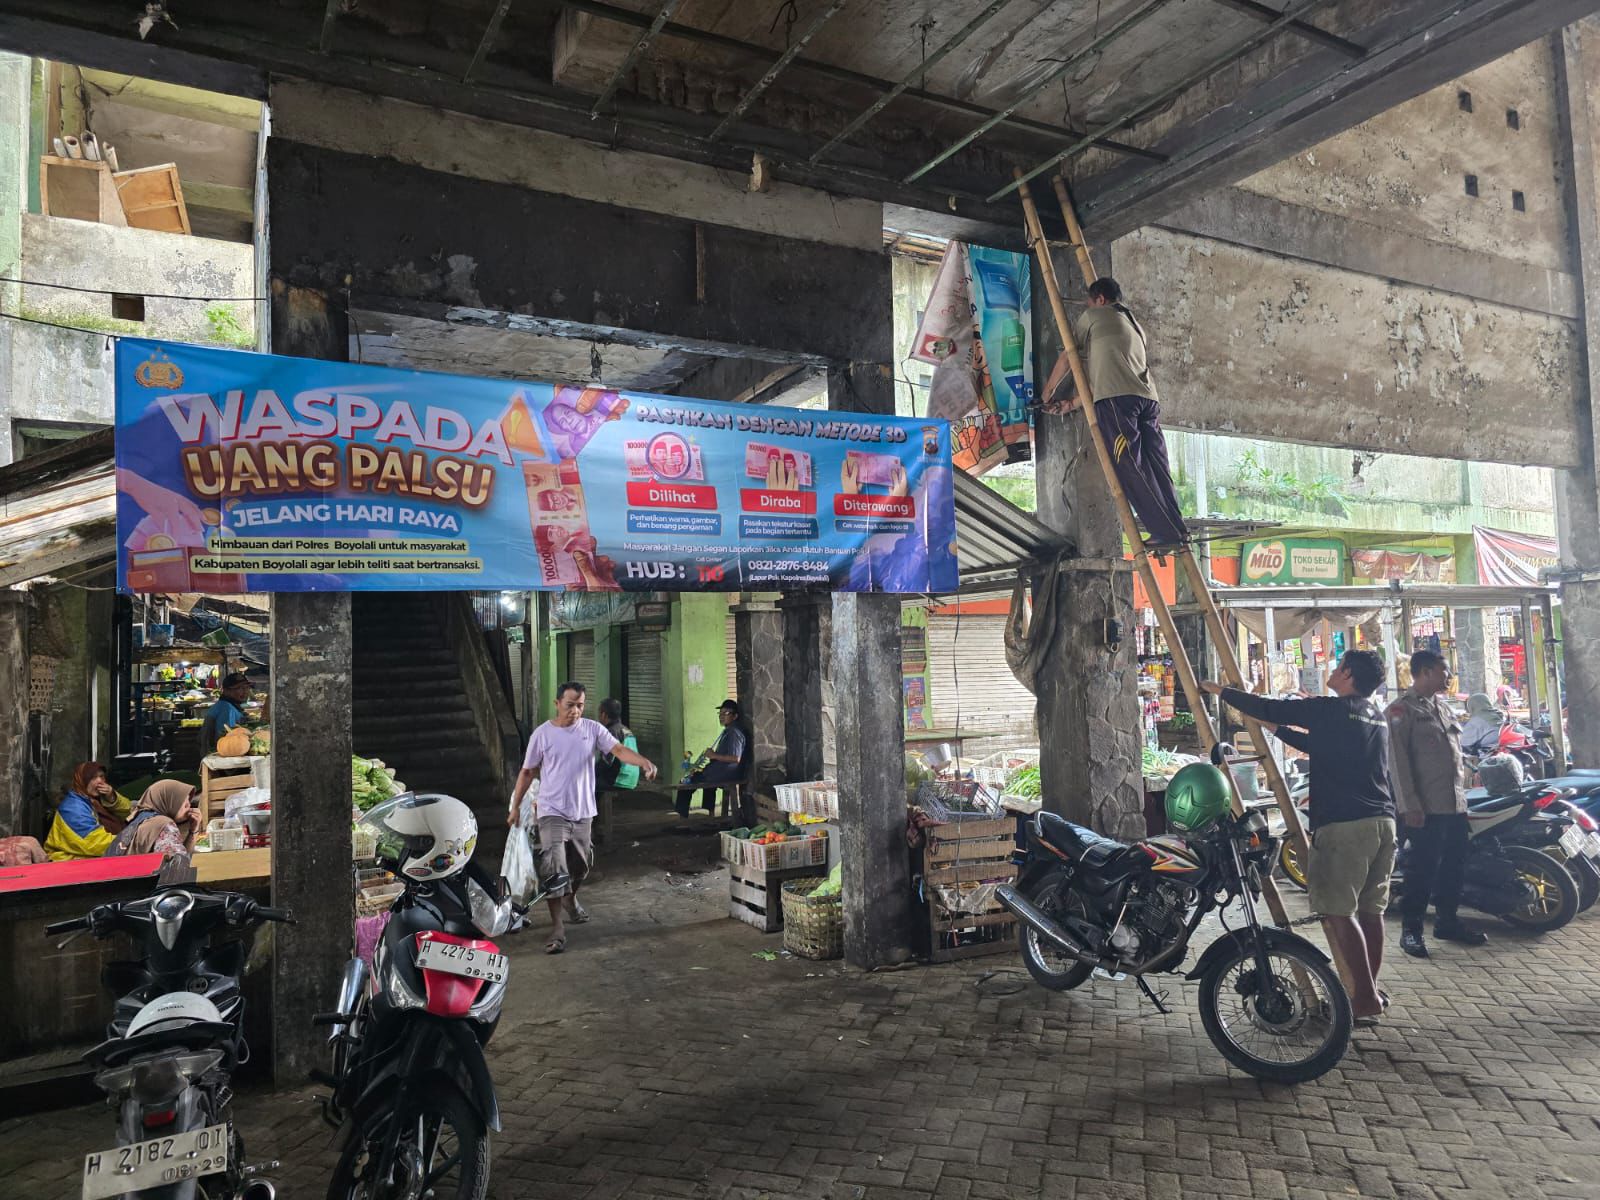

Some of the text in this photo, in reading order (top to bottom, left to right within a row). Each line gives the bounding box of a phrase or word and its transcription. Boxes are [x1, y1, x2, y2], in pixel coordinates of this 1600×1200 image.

[156, 389, 515, 466] WASPADA
[636, 404, 907, 444] PASTIKAN DENGAN METODE 3D
[185, 443, 493, 506] UANG PALSU
[649, 489, 697, 503] Dilihat
[760, 495, 801, 508] Diraba
[843, 499, 909, 514] Diterawang
[232, 504, 460, 532] JELANG HARI RAYA
[630, 513, 668, 522] Perhatikan
[743, 519, 771, 527] Rasakan
[771, 520, 793, 528] tekstur
[651, 522, 678, 531] benang
[763, 528, 785, 536] bagian
[211, 539, 466, 552] Himbauan dari Polres Boyolali untuk masyarakat
[623, 542, 672, 552] Masyarakat
[672, 543, 703, 553] Jangan
[703, 544, 728, 553] Segan
[728, 545, 765, 554] Laporkan
[194, 558, 481, 572] Kabupaten Boyolali agar lebih teliti saat bertransaksi.
[748, 560, 829, 572] 0821-2876-8484
[1250, 553, 1282, 568] MILO
[1293, 555, 1336, 565] TOKO SEKAR
[422, 940, 503, 968] H 4275 HI
[87, 1155, 101, 1175] H
[119, 1139, 174, 1168] 2182
